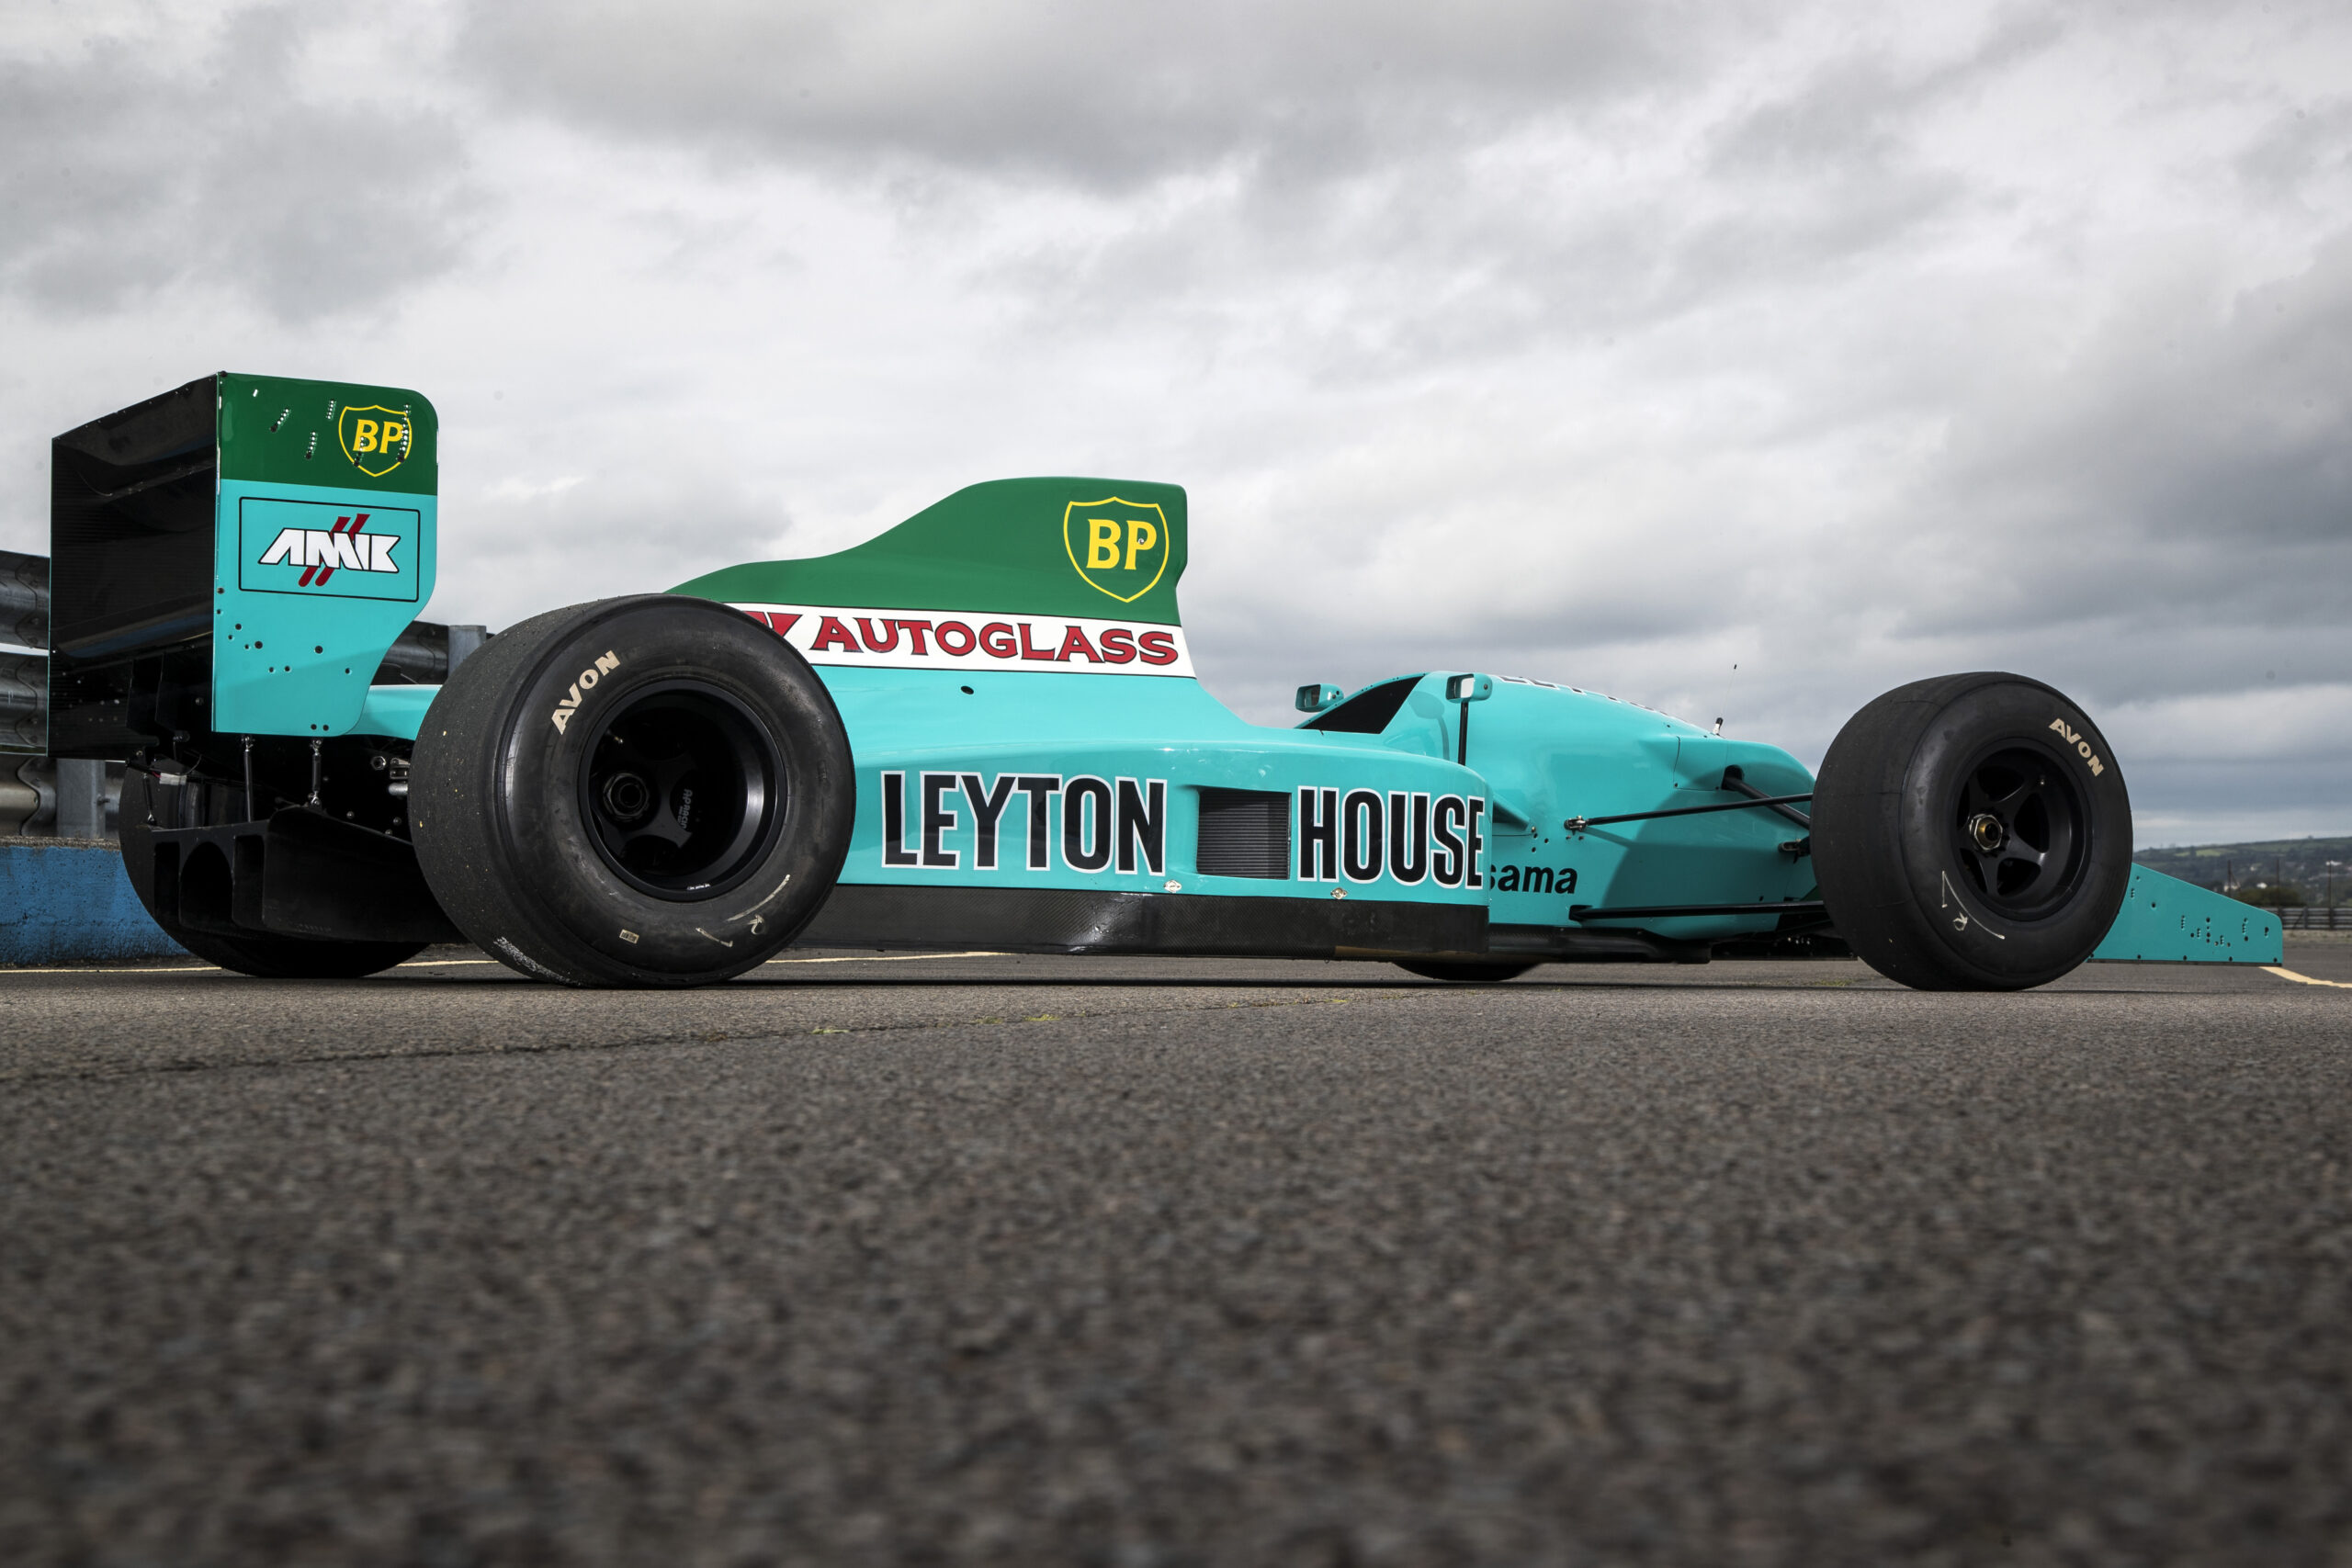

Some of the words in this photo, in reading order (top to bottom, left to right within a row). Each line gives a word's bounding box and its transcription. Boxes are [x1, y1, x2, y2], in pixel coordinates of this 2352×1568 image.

[353, 418, 404, 454] BP
[1086, 518, 1158, 570] BP
[809, 615, 1179, 666] AUTOGLASS
[551, 650, 621, 735] AVON
[2048, 718, 2104, 777] AVON
[881, 770, 1168, 876] LEYTON
[1297, 785, 1486, 890] HOUSE
